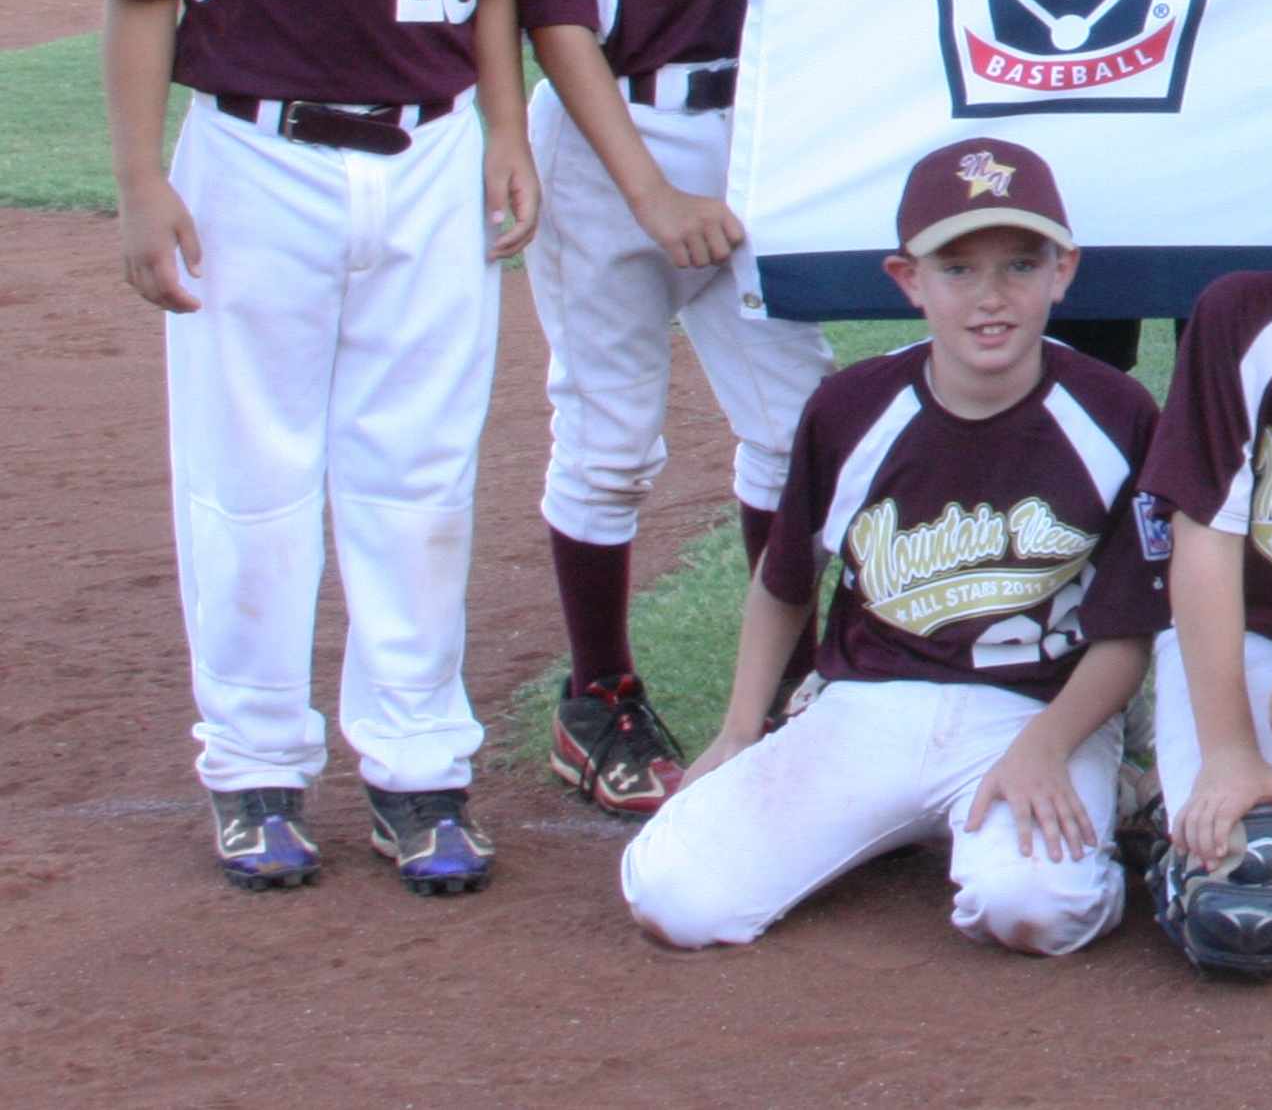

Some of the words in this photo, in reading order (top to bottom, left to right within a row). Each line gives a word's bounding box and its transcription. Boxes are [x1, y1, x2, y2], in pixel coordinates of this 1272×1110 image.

[985, 49, 1152, 87] BASEBALL
[851, 502, 1006, 606] Mountain
[1009, 500, 1086, 557] View
[909, 597, 940, 621] ALL
[1002, 580, 1042, 597] 2011
